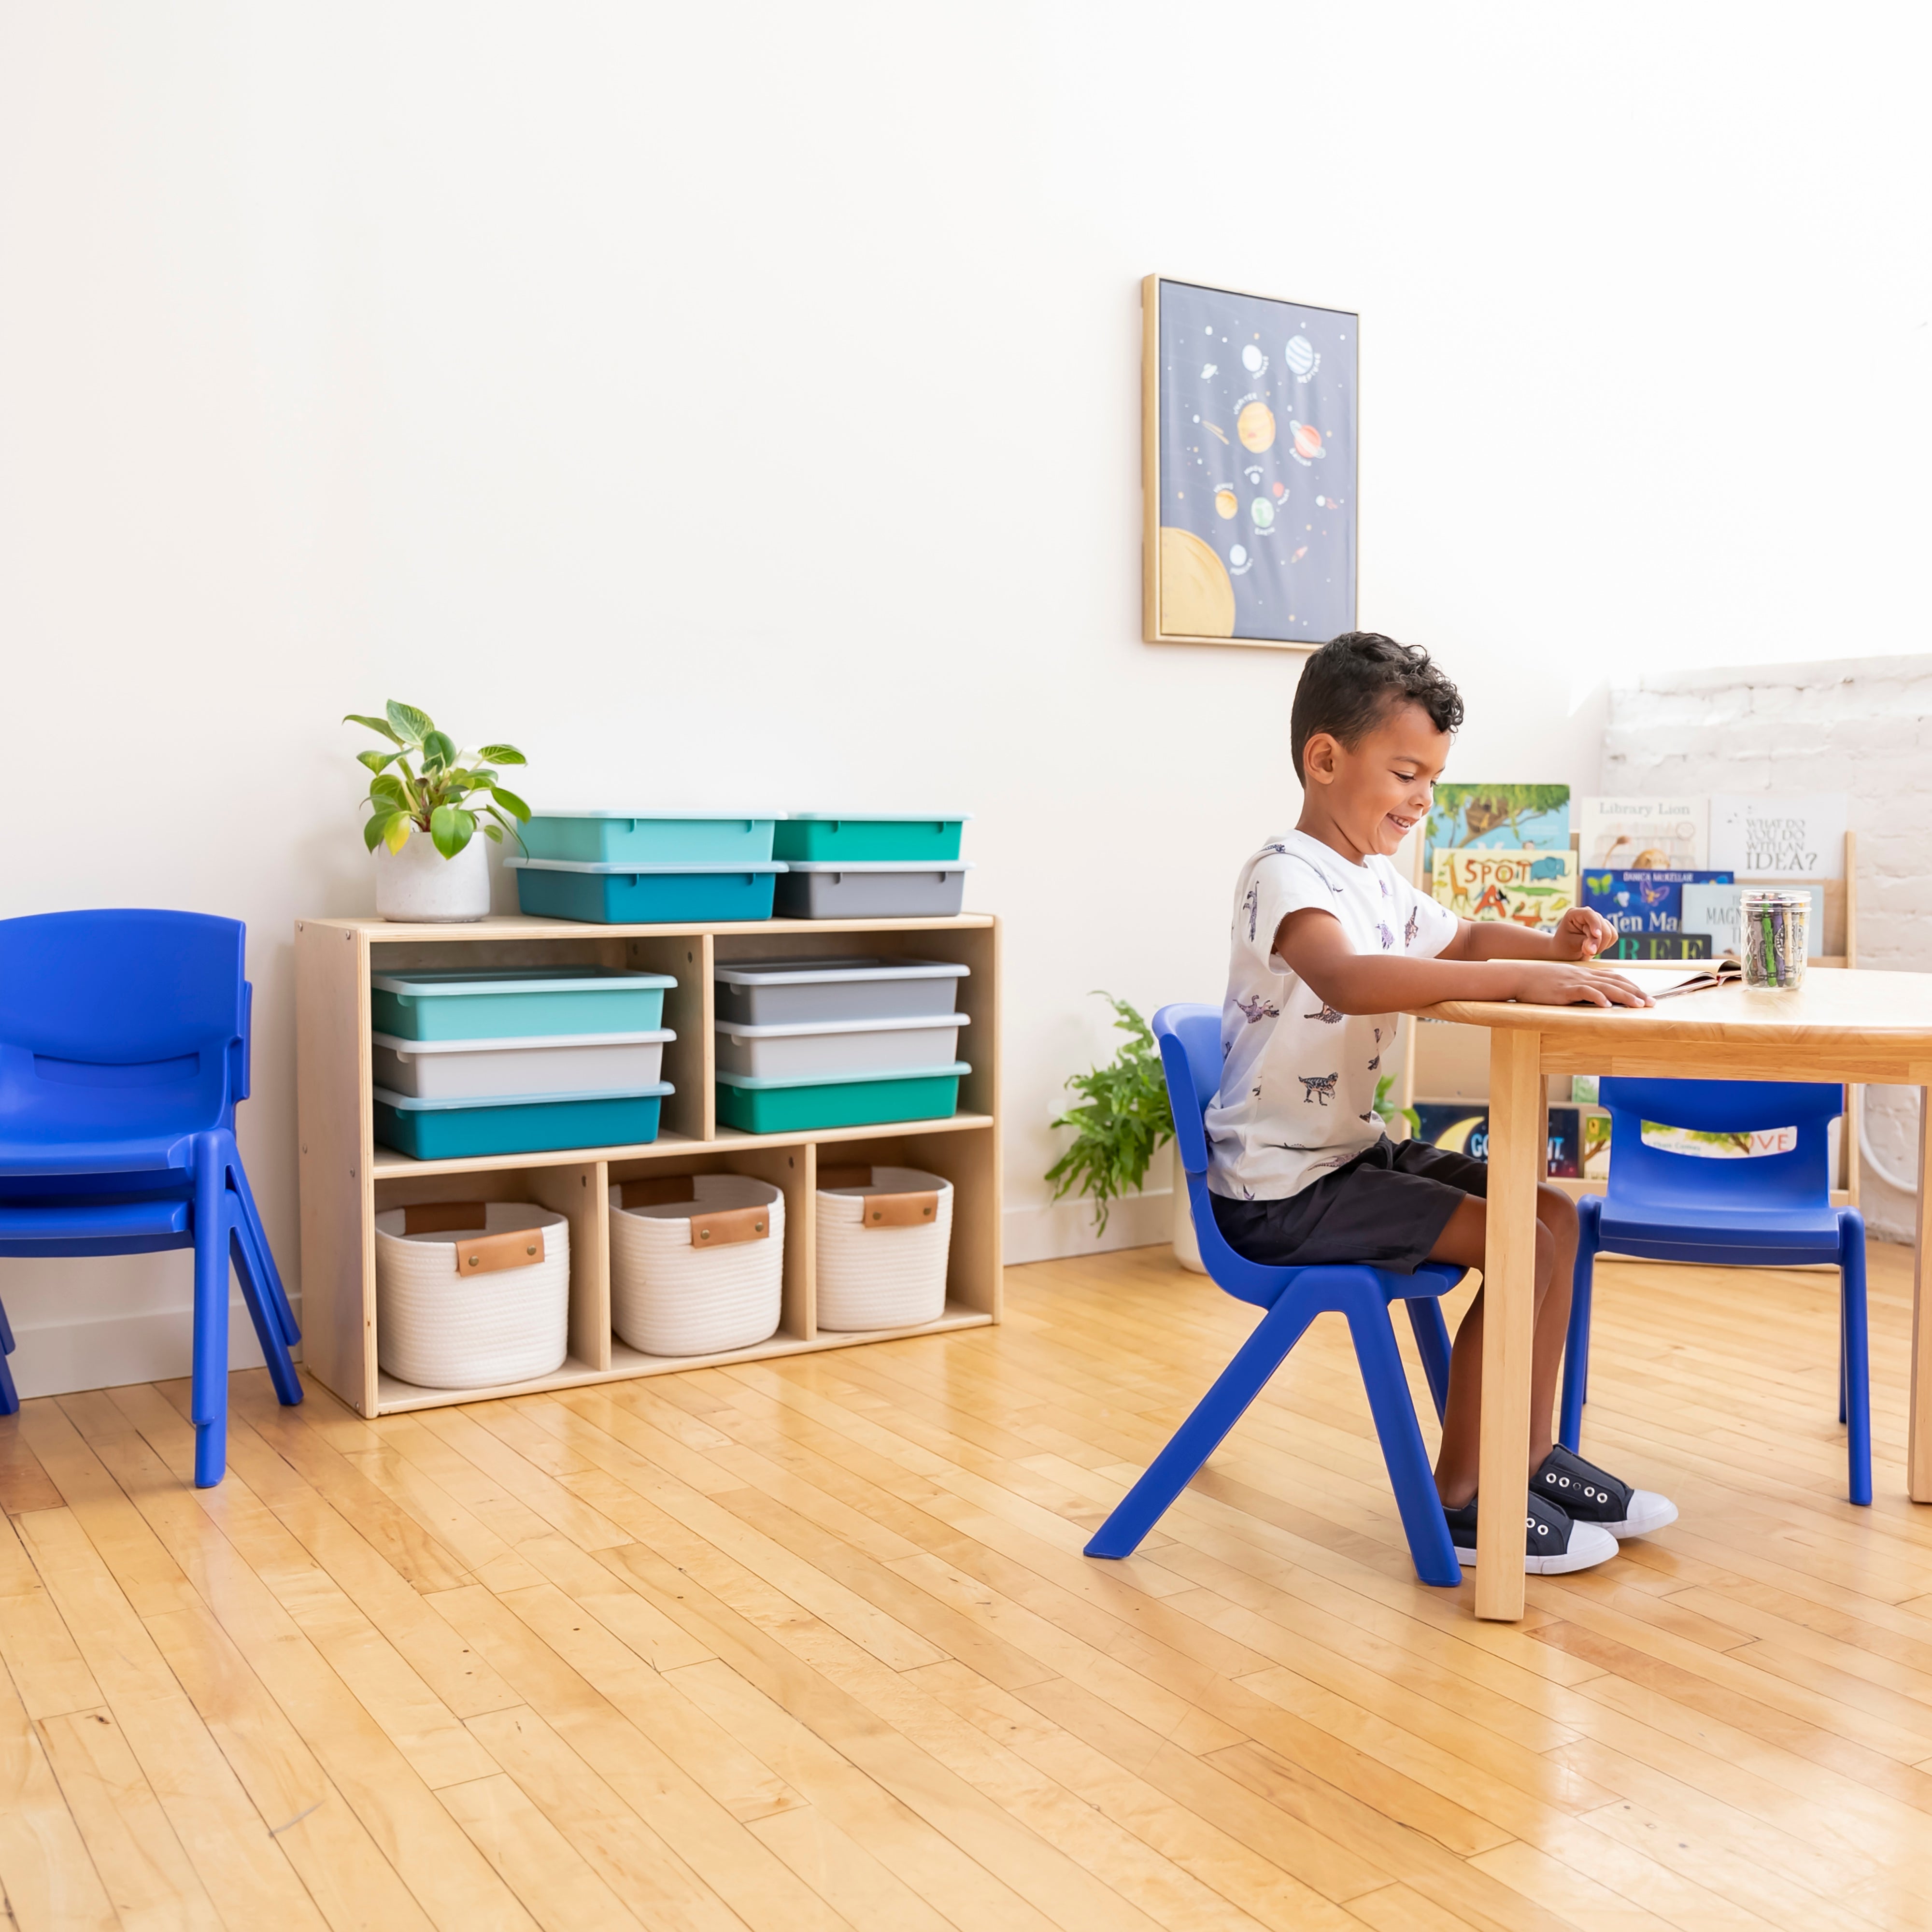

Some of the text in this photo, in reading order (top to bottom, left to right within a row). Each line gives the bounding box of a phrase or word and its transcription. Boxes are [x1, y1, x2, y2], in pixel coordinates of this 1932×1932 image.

[1599, 802, 1690, 818] Library Lion
[1746, 818, 1805, 829] WHAT DO
[1746, 829, 1805, 841] YOU DO
[1746, 841, 1804, 852] WITH AN
[1746, 852, 1818, 870] IDEA?
[1464, 859, 1532, 883] SPOT
[1606, 911, 1682, 932] Ten Ma
[1595, 938, 1704, 960] REE
